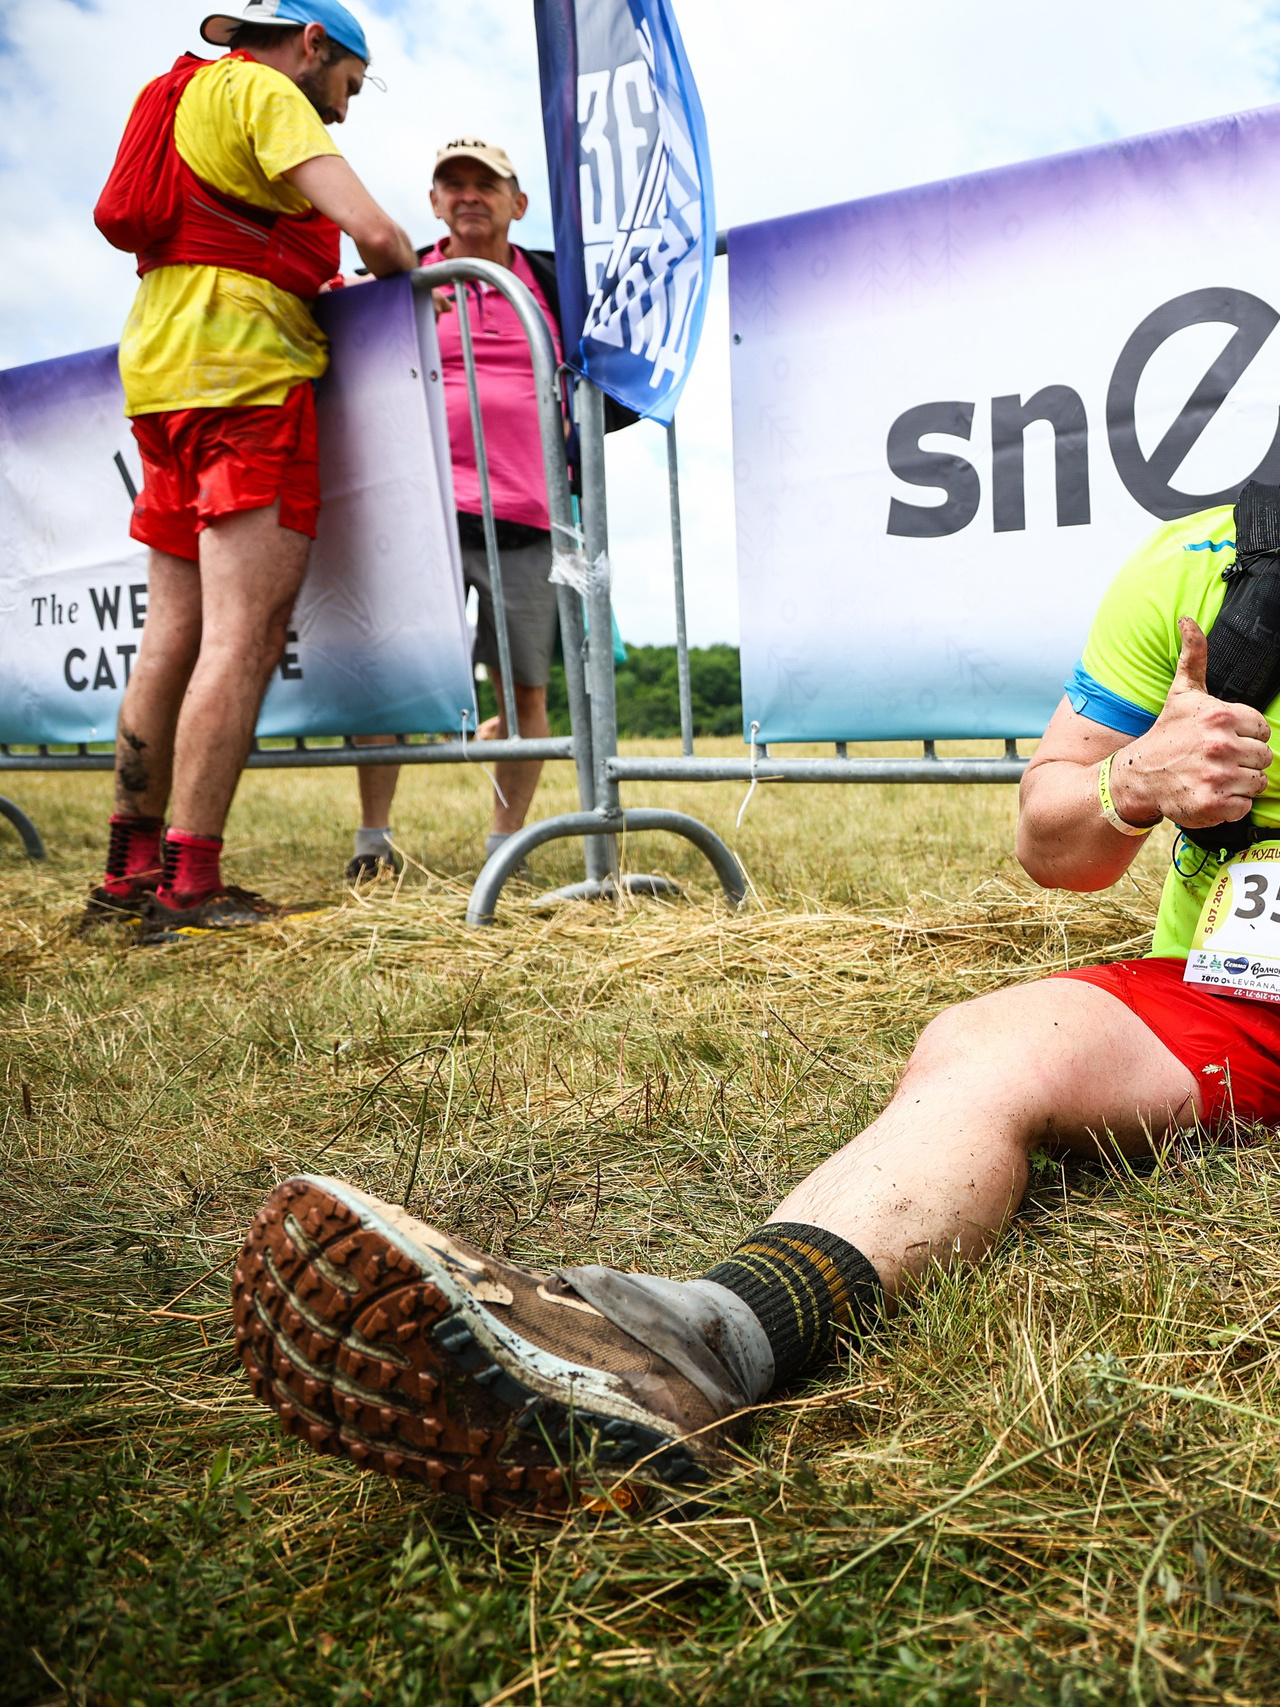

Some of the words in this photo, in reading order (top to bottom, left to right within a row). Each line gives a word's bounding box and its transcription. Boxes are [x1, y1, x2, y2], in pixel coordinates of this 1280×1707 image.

[31, 593, 79, 627] The
[1204, 876, 1229, 935] 5.07.2026
[1232, 977, 1276, 990] LEVRANA
